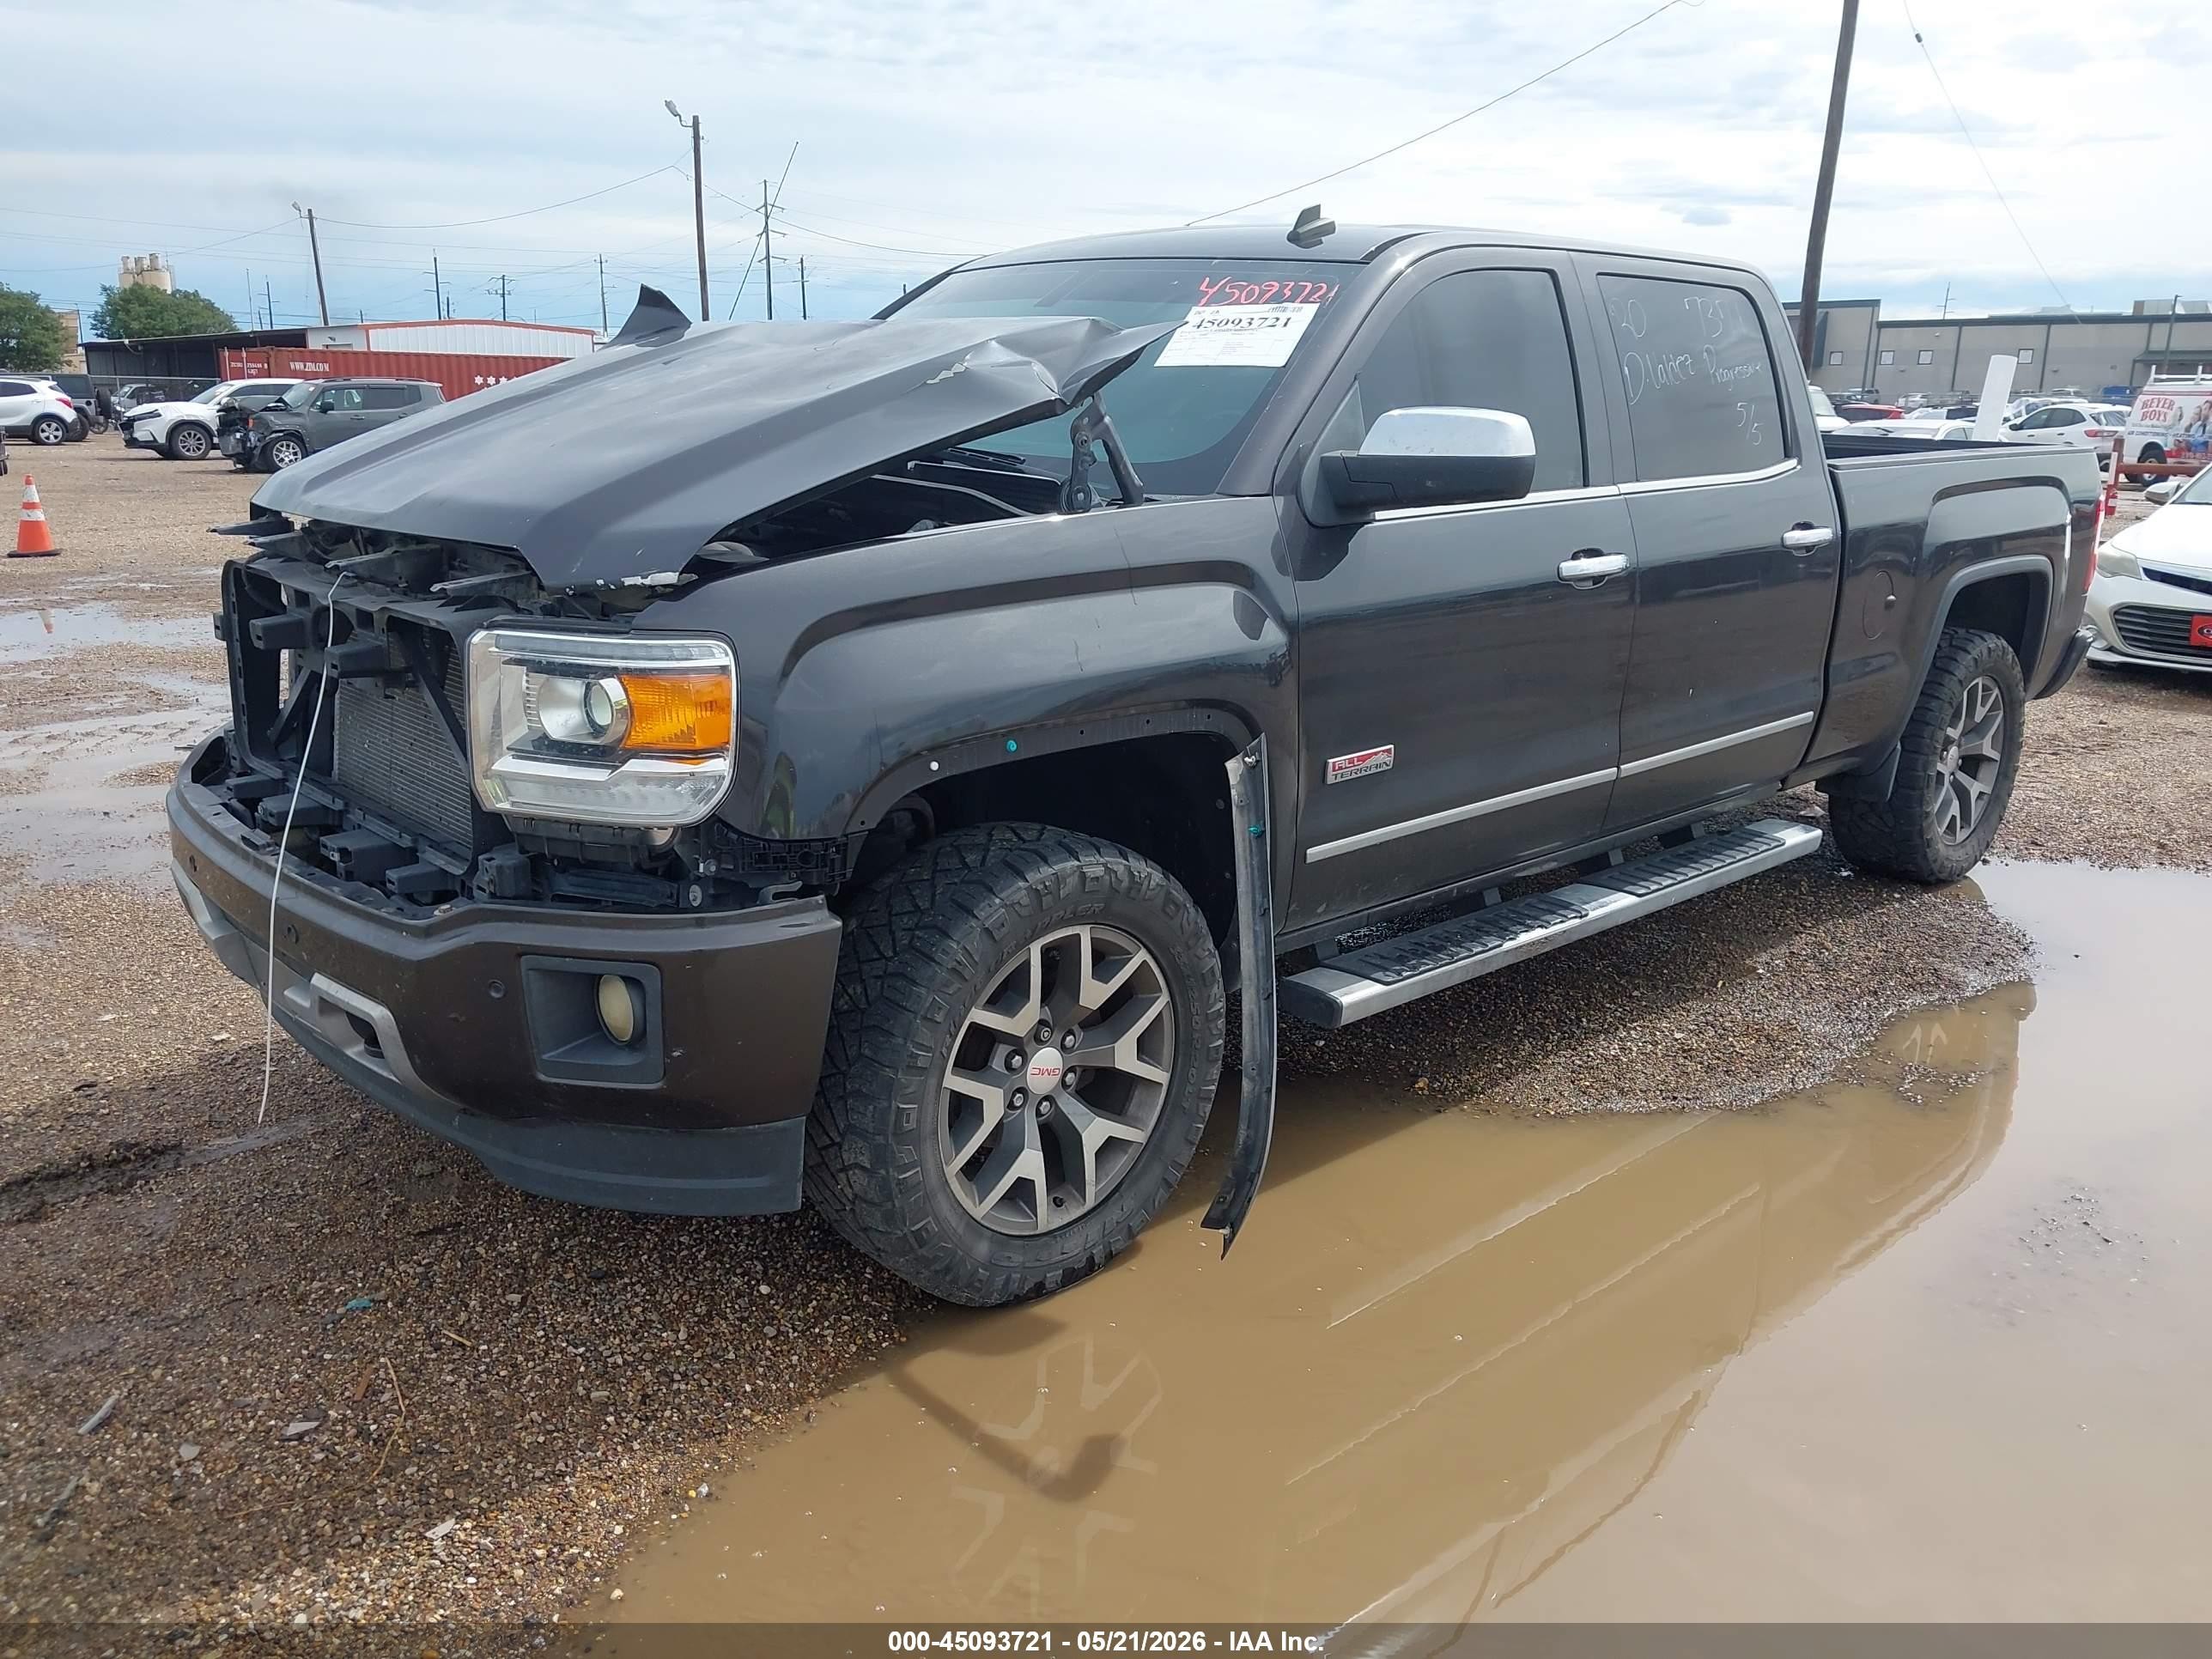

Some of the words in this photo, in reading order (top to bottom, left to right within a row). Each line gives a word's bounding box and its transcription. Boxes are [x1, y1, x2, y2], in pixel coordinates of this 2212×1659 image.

[1199, 276, 1340, 307] 45093721
[1192, 317, 1291, 330] 45093721
[2141, 398, 2175, 411] BEYER
[2140, 410, 2167, 422] BOYS
[1334, 757, 1364, 770] ALL
[1332, 760, 1392, 781] TERRAIN
[1030, 1067, 1060, 1076] GMC
